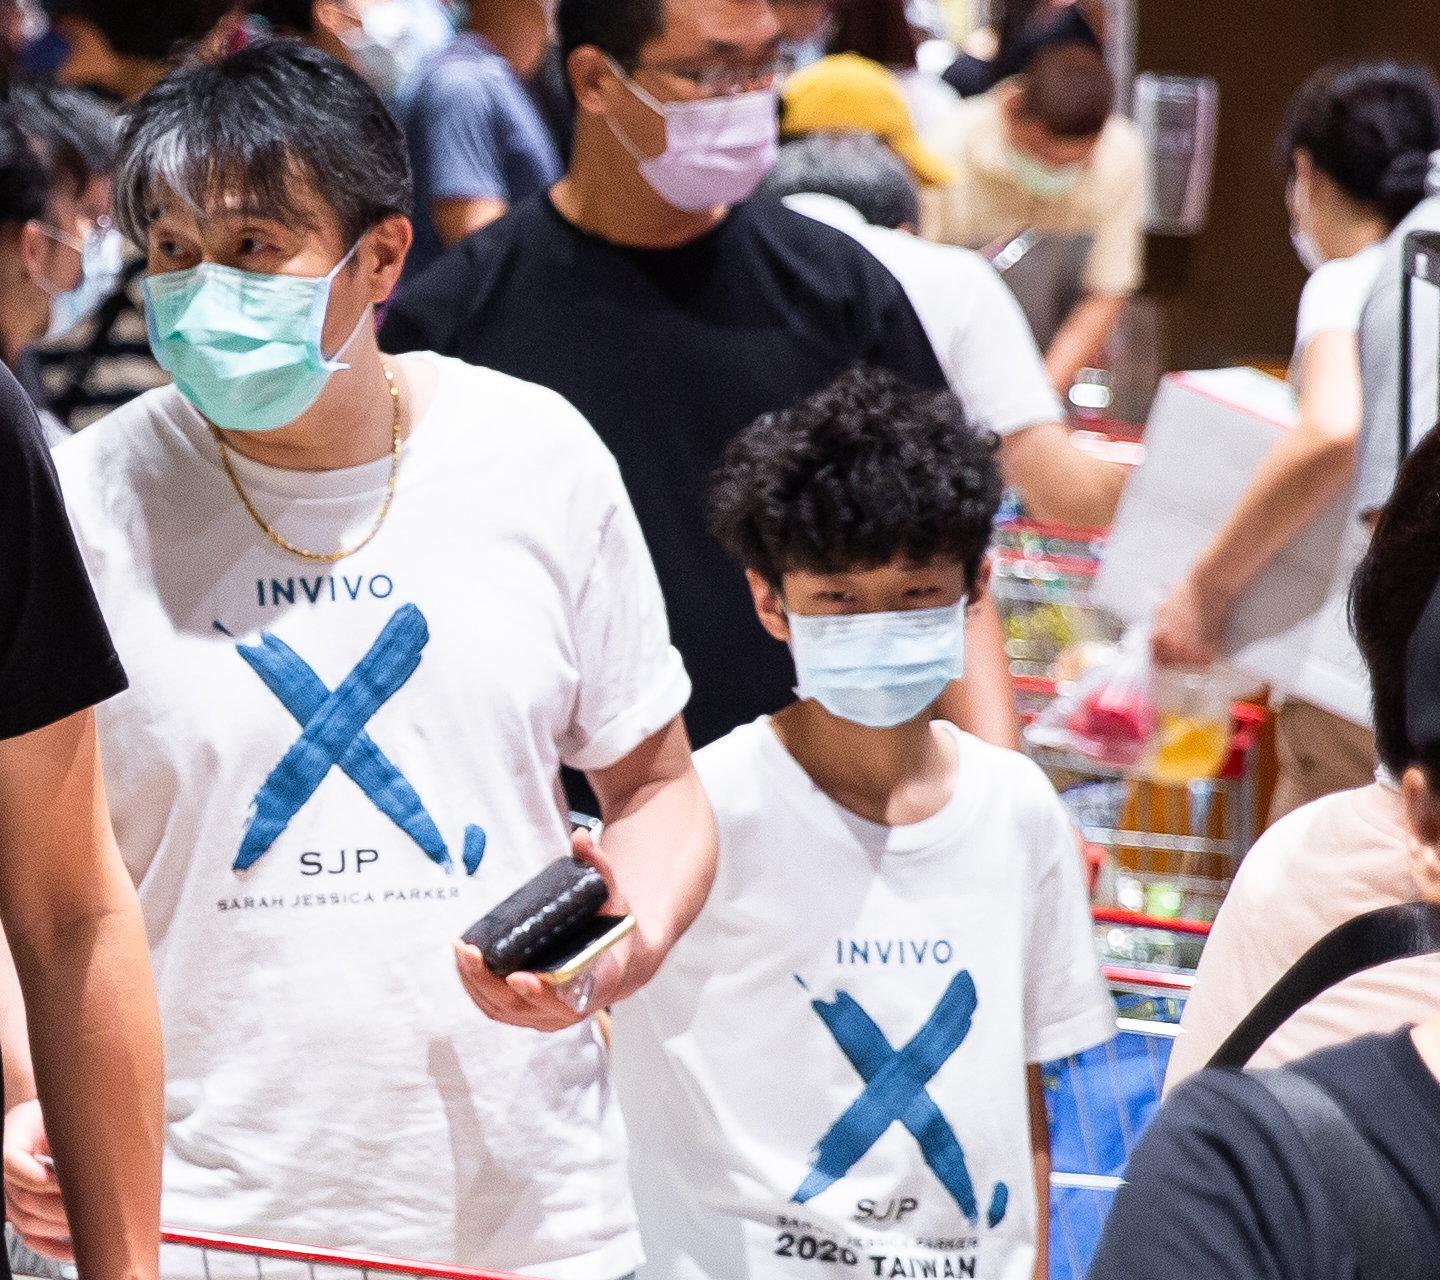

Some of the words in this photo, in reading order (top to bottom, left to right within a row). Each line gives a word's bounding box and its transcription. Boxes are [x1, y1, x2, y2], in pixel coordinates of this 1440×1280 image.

[256, 573, 394, 608] INVIVO
[298, 848, 380, 877] SJP
[216, 896, 285, 914] SARAH
[288, 891, 378, 910] JESSICA
[383, 885, 460, 904] PARKER
[836, 938, 953, 965] INVIVO
[853, 1195, 920, 1223] SJP
[774, 1231, 859, 1267] 2020
[869, 1254, 977, 1280] TAIWAN
